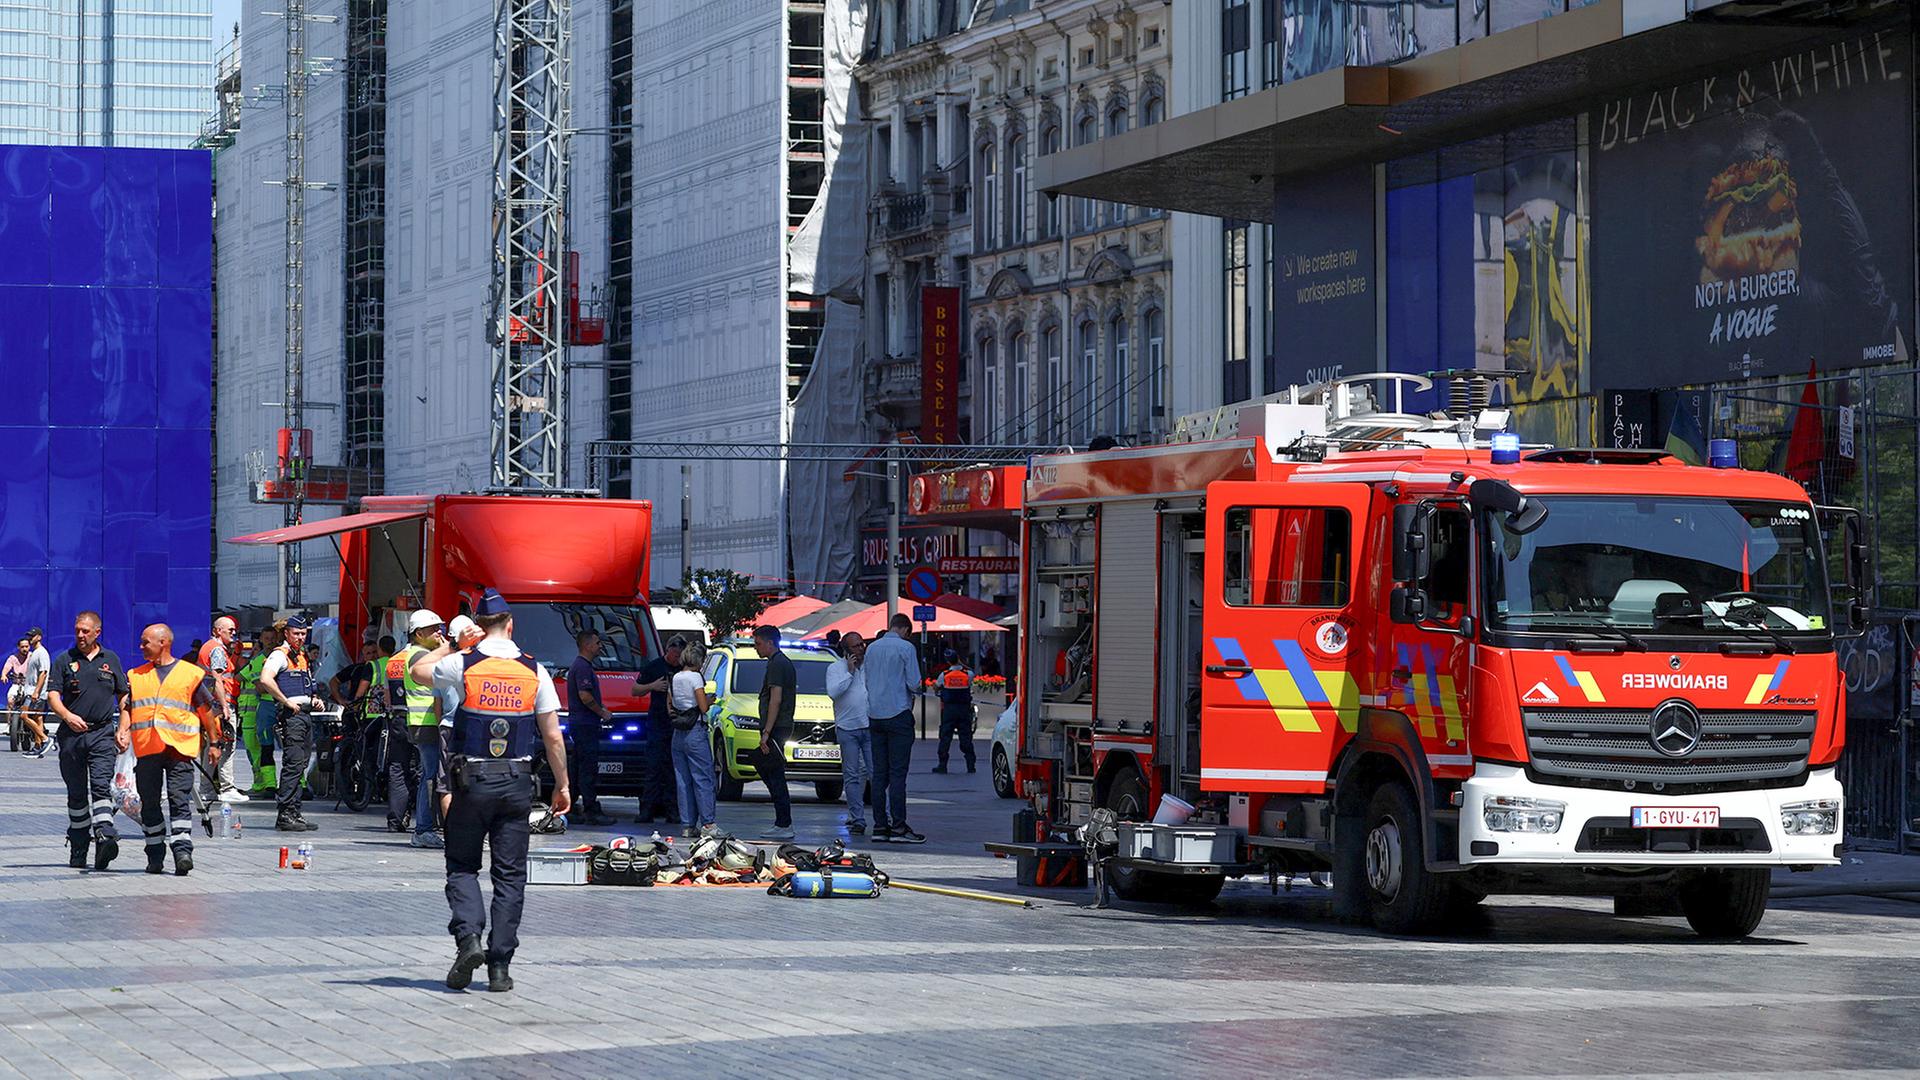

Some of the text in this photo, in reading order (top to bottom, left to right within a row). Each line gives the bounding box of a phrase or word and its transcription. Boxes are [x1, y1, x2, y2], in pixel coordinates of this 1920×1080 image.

[1600, 29, 1902, 151] BLACK & WHITE
[1297, 249, 1358, 276] We create new
[1296, 274, 1367, 304] workspaces here
[1695, 267, 1800, 309] NOT A BURGER,
[1709, 304, 1779, 345] A VOGUE
[1863, 343, 1897, 360] IMMOBEL
[935, 306, 946, 445] BRUSSELS
[1613, 394, 1624, 449] BLACK
[863, 536, 917, 566] BRUSELS
[940, 559, 1020, 571] RESTAURAN
[479, 694, 522, 709] Politie
[483, 681, 521, 695] Police
